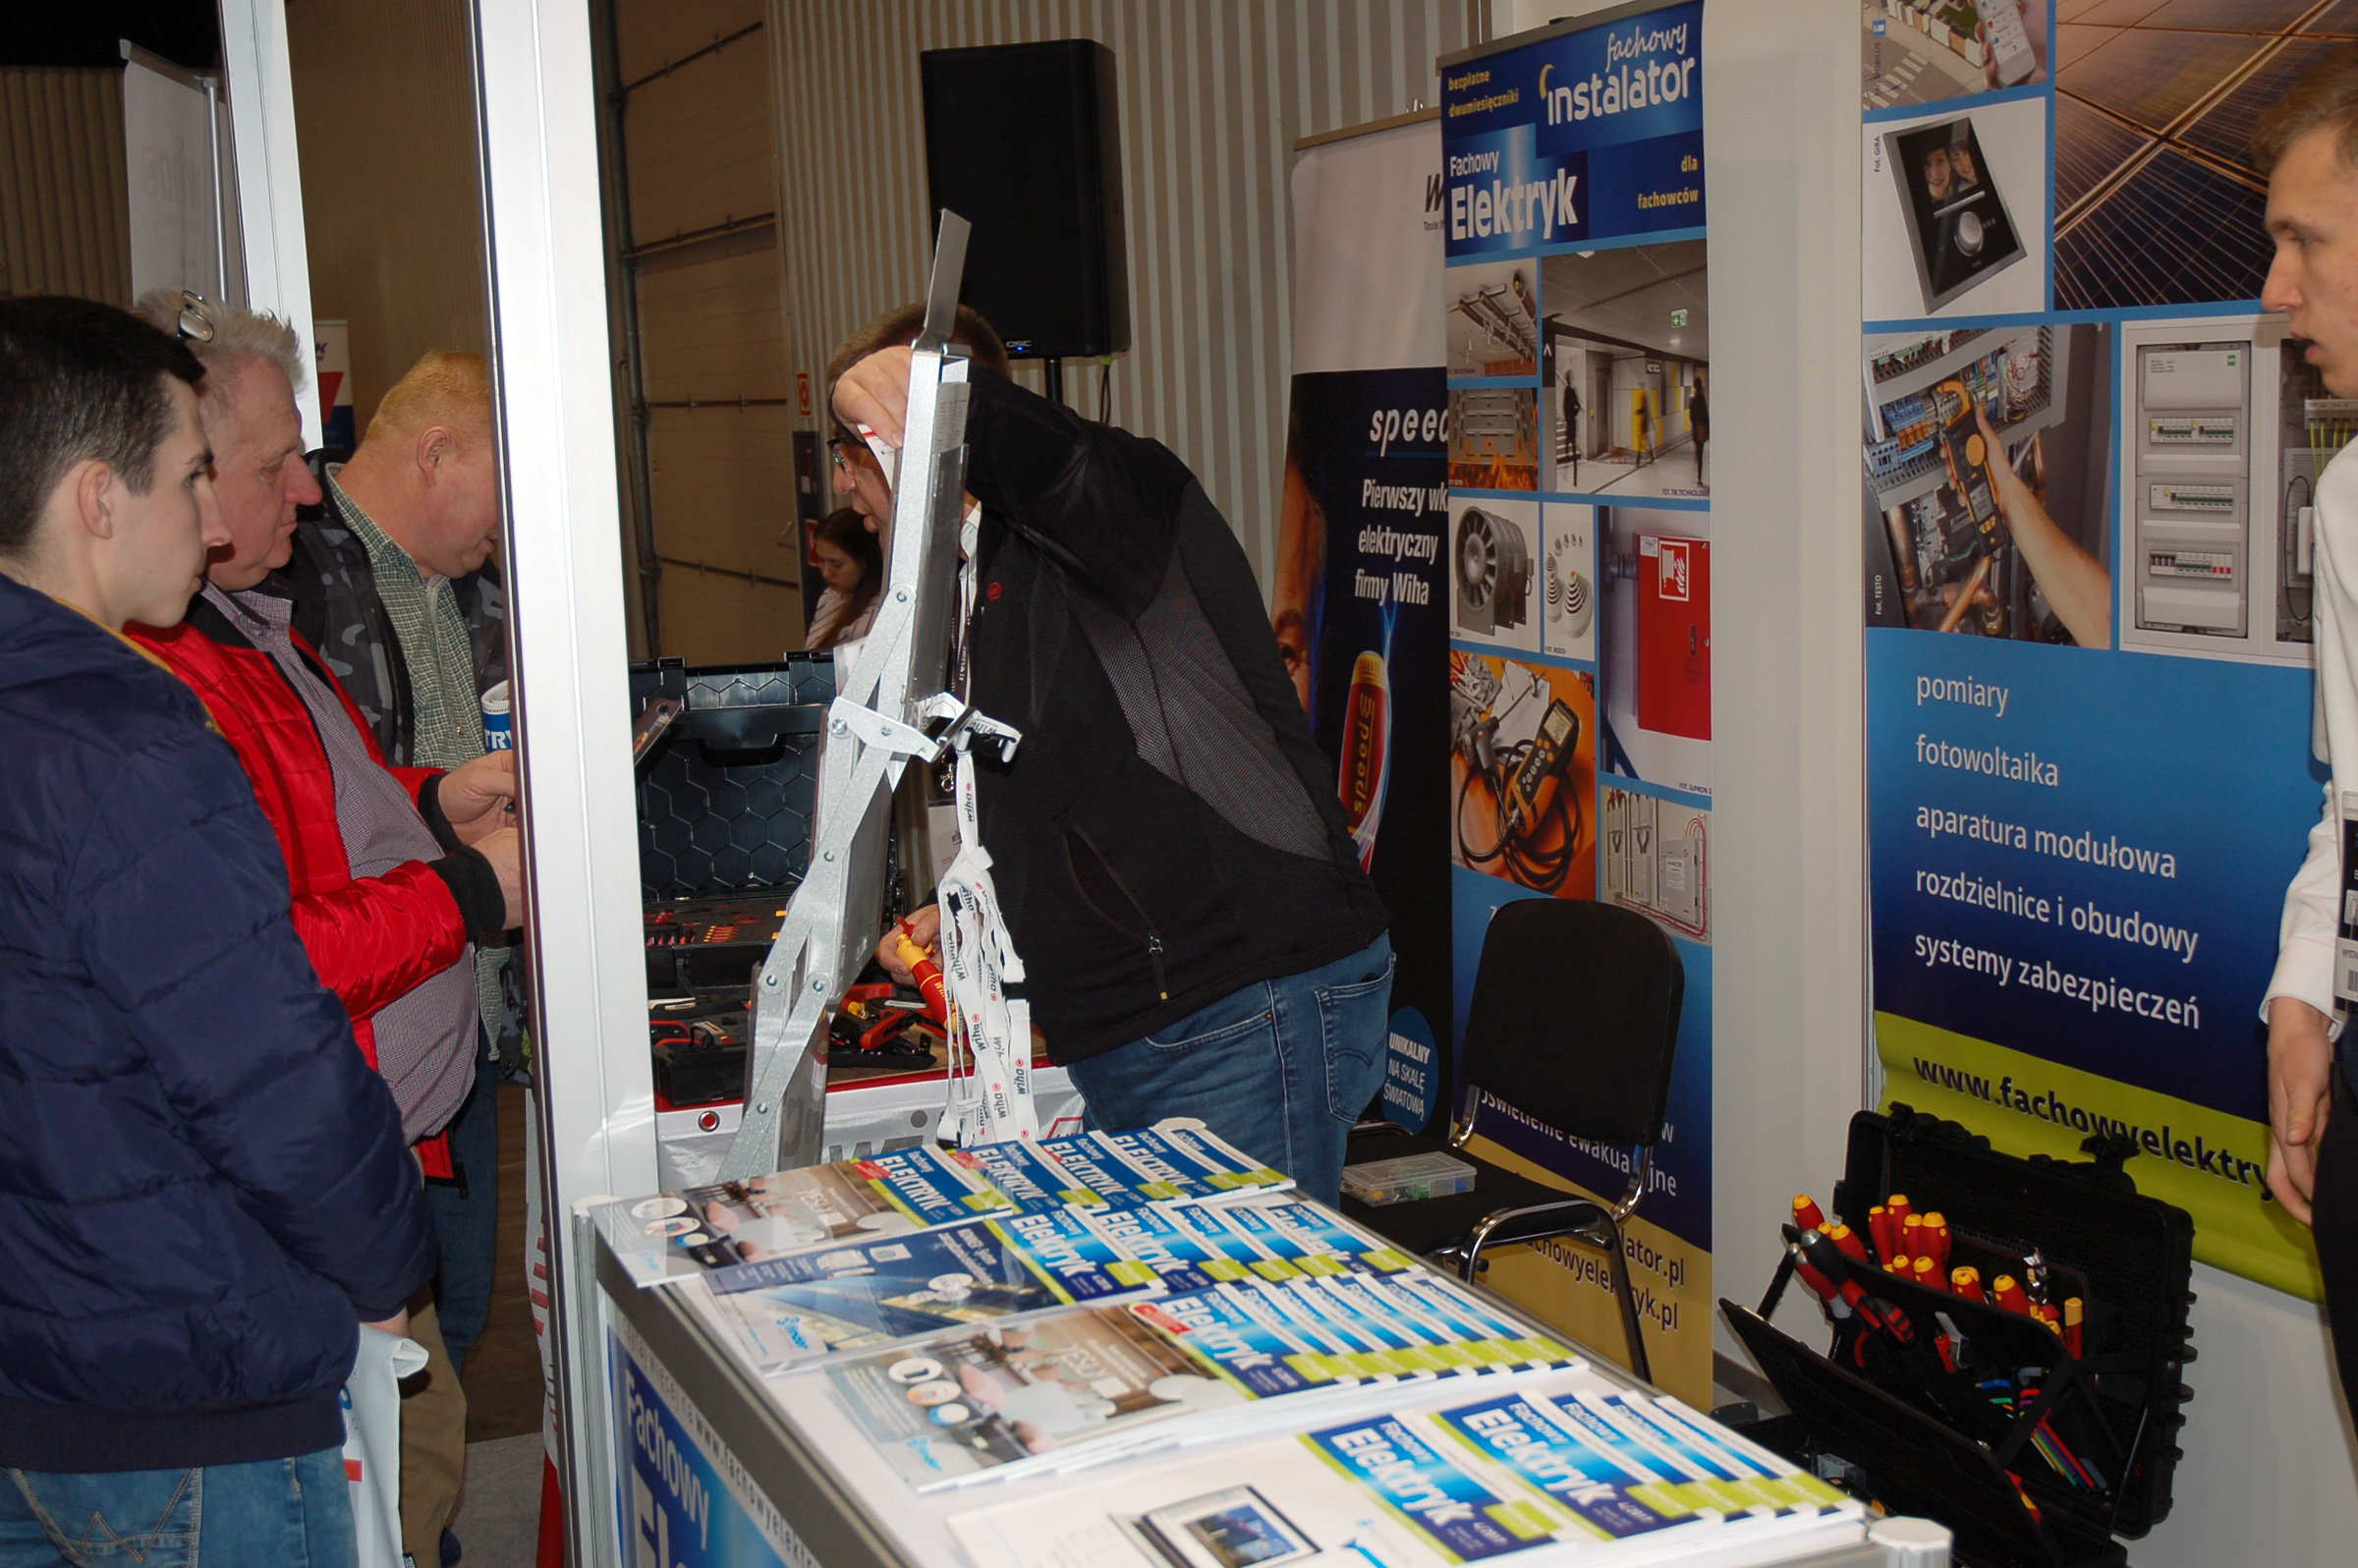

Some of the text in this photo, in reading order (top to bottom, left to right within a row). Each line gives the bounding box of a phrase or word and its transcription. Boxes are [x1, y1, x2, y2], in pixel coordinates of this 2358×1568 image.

[1605, 23, 1688, 72] fachowy
[1448, 70, 1490, 92] bezpłatne
[1448, 88, 1519, 118] dwumiesięczniki
[1540, 56, 1696, 126] instalator
[1449, 150, 1500, 177] Fachowy
[1681, 155, 1699, 173] dla
[1451, 168, 1578, 241] Elektryk
[1637, 187, 1699, 209] fachowców
[1362, 478, 1427, 517] Pierwszy
[1358, 524, 1438, 566] elektryczny
[1355, 568, 1430, 605] firmy Wiha
[1874, 575, 1882, 599] TESTO
[1916, 672, 2008, 717] pomiary
[1916, 734, 2058, 787] fotowoltaika
[965, 793, 974, 822] wiha
[1916, 803, 2176, 879] aparatura modułowa
[1916, 868, 2199, 964] rozdzielnice i obudowy
[1915, 930, 2200, 1030] systemy zabezpieczeń
[972, 1023, 986, 1052] wiha
[1389, 1032, 1431, 1065] UNIKALNY
[1013, 1068, 1027, 1095] wiha
[1388, 1058, 1426, 1094] NA SKALĘ
[993, 1092, 1007, 1119] wiha
[1383, 1078, 1425, 1121] ŚWIATOWĄ
[873, 1155, 952, 1211] ELEKTRYK
[971, 1148, 1048, 1202] ELEKTRYK
[1042, 1141, 1129, 1196] ELEKTRYK
[1569, 1135, 1677, 1197] ewakuajne
[1010, 1213, 1097, 1277] Elektryk
[1094, 1210, 1190, 1275] Elektryk
[1159, 1296, 1274, 1372] Elektryk
[1379, 1421, 1436, 1463] Fachowy
[1508, 1402, 1570, 1444] Fachowy
[627, 1368, 709, 1551] Fachowy
[1330, 1428, 1476, 1528] Elektryk
[1462, 1408, 1619, 1507] Elektryk
